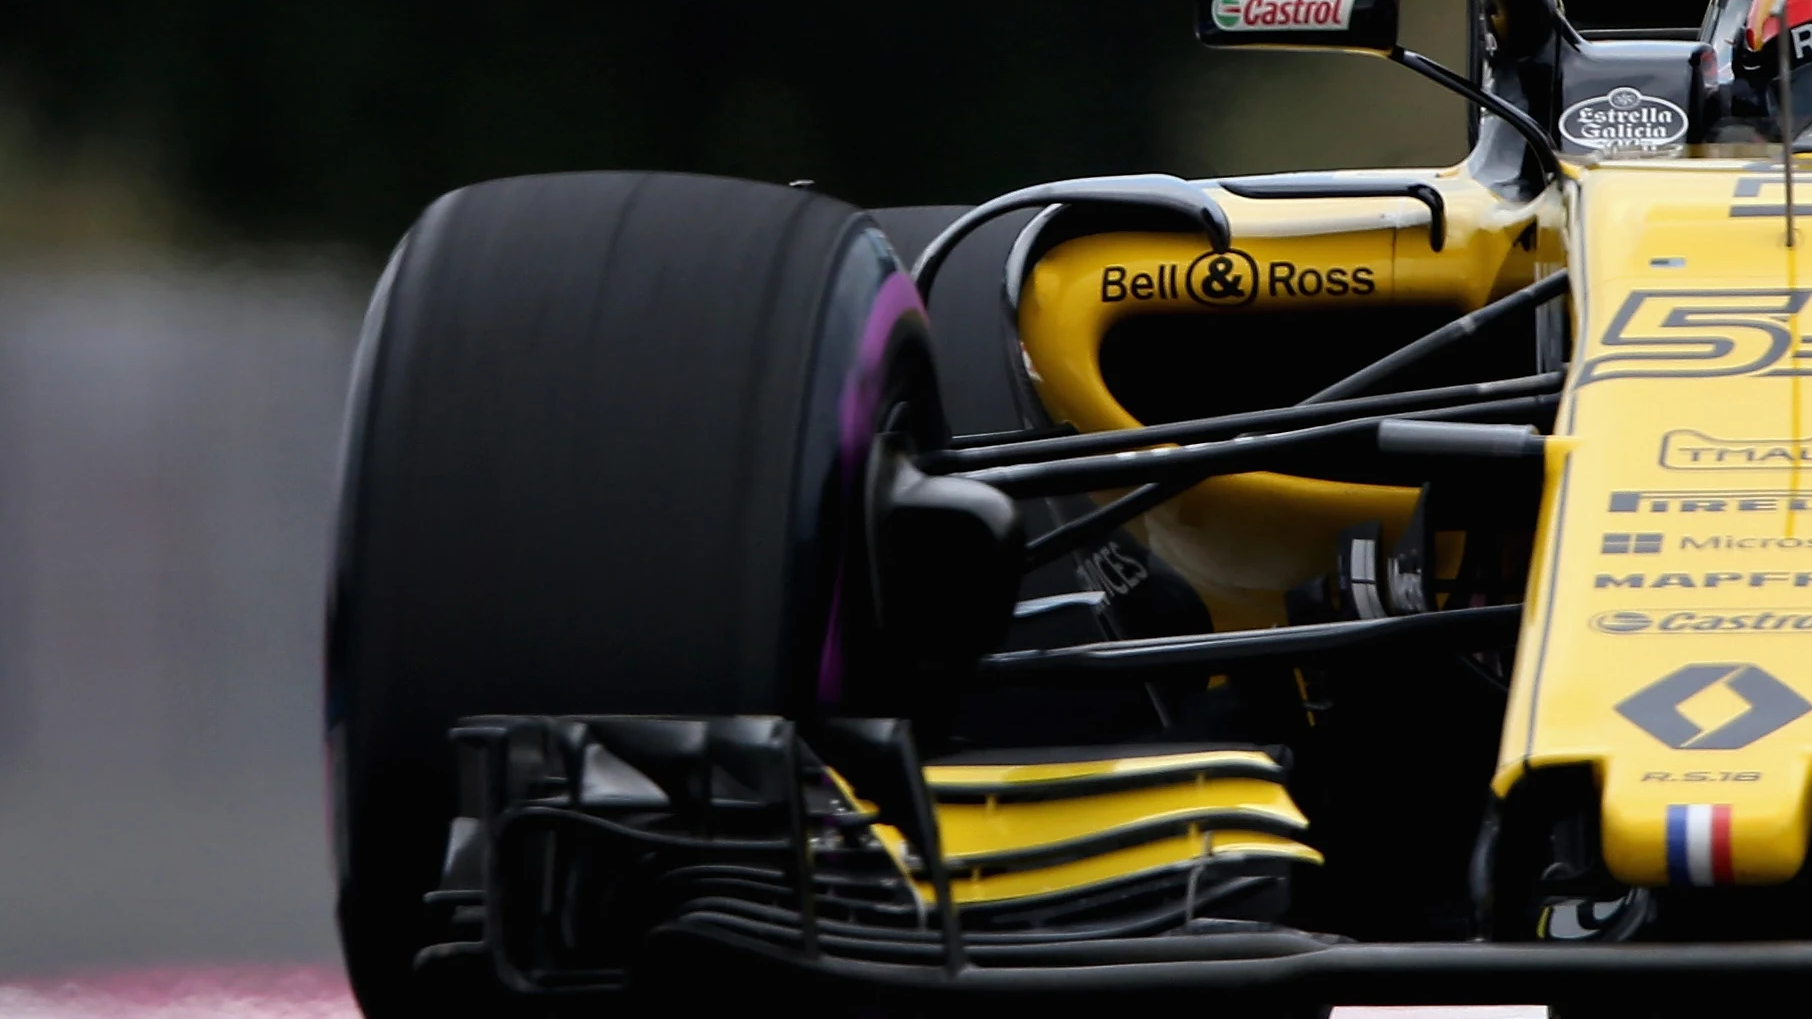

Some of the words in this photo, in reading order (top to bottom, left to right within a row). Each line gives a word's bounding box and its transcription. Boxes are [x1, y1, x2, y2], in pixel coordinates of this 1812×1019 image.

[1577, 107, 1673, 123] Estrella
[1580, 123, 1668, 139] Galicia
[1101, 264, 1178, 303] Bell
[1269, 261, 1376, 297] Ross
